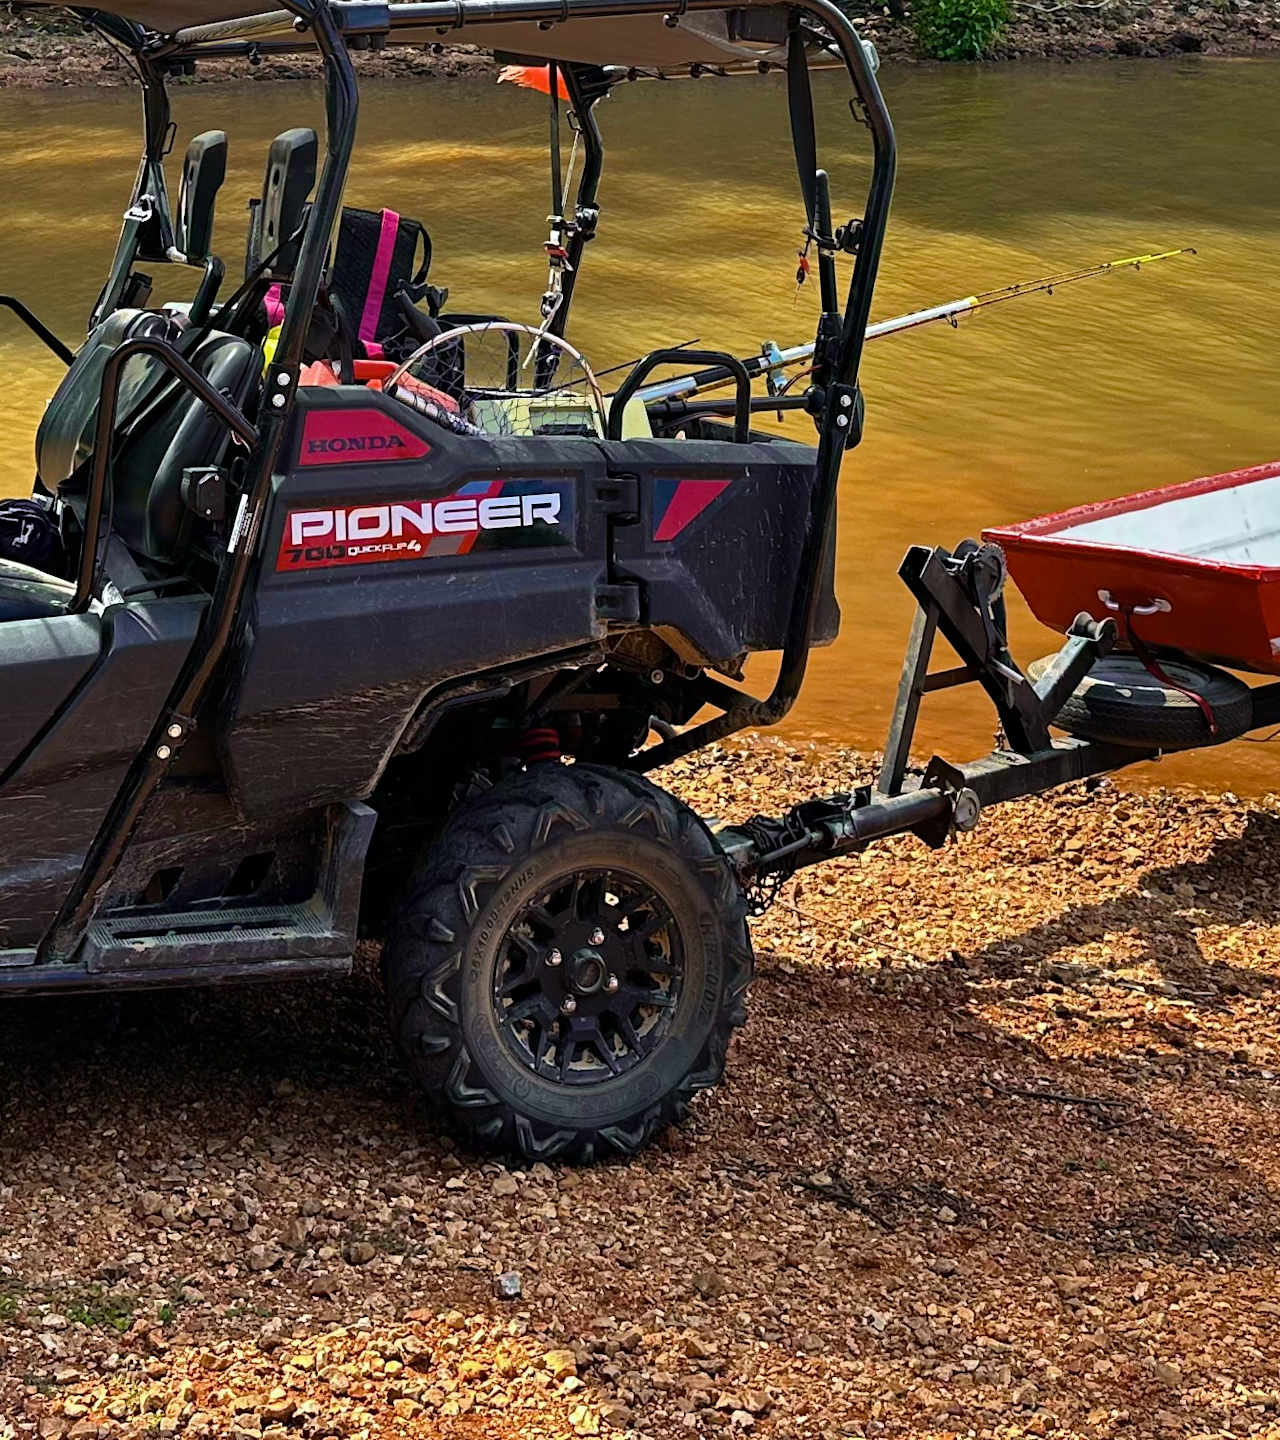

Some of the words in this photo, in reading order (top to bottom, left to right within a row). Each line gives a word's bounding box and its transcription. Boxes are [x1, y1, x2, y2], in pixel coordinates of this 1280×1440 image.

[308, 435, 406, 454] HONDA
[291, 493, 560, 545] PIONEER
[285, 545, 346, 563] 700
